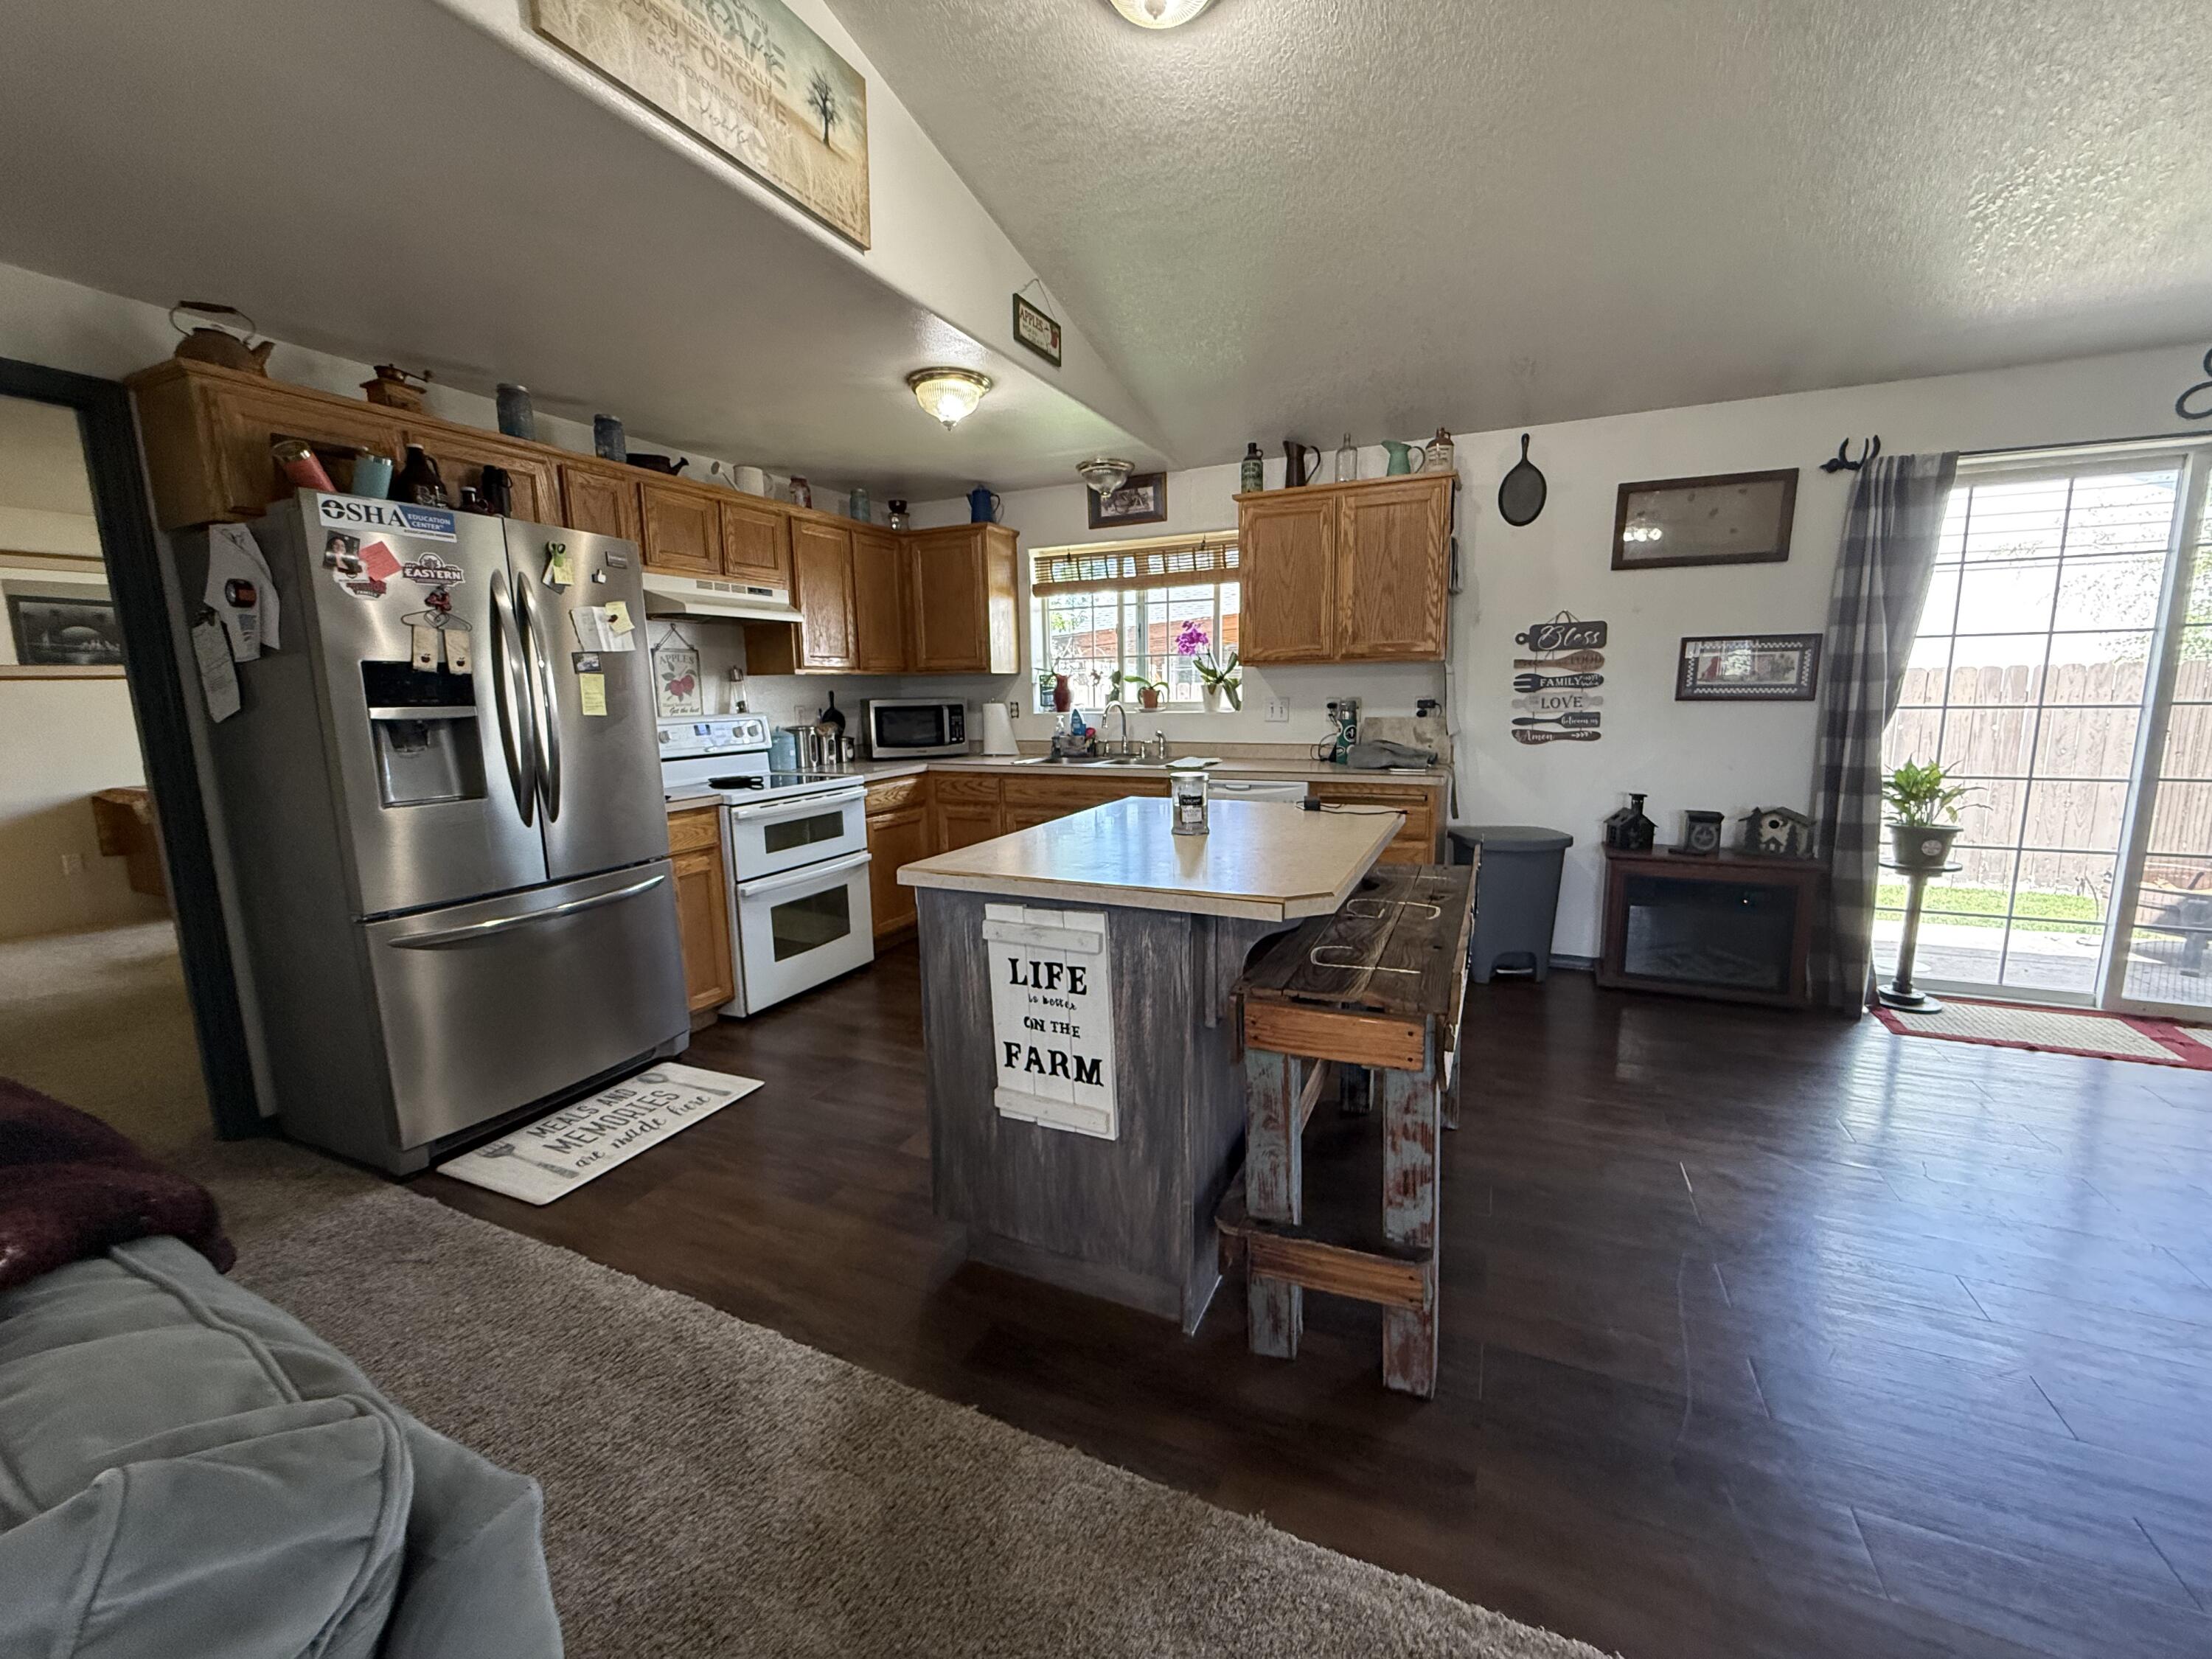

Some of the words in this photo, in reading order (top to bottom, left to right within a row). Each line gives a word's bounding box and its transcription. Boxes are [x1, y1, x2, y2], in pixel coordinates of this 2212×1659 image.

[685, 27, 787, 128] FORGIVE
[678, 72, 768, 174] HUG
[1020, 308, 1043, 332] APPLES
[321, 500, 406, 527] OSHA
[408, 514, 451, 525] EDUCATION
[405, 567, 462, 580] EASTERN
[1538, 625, 1600, 650] Bless
[660, 655, 694, 664] APPLES
[1540, 675, 1582, 687] FAMILY
[1541, 695, 1583, 709] LOVE
[1525, 730, 1554, 742] Amen
[1008, 958, 1087, 995] LIFE
[1029, 994, 1038, 1004] is
[1042, 996, 1077, 1011] better
[1023, 1016, 1046, 1032] ON
[1051, 1020, 1081, 1039] THE
[1003, 1041, 1105, 1087] FARM
[526, 1105, 599, 1138] MEALS
[597, 1088, 637, 1107] AND
[543, 1090, 680, 1155] MEMORIES
[575, 1150, 605, 1168] are
[611, 1117, 667, 1149] made
[667, 1095, 711, 1116] here
